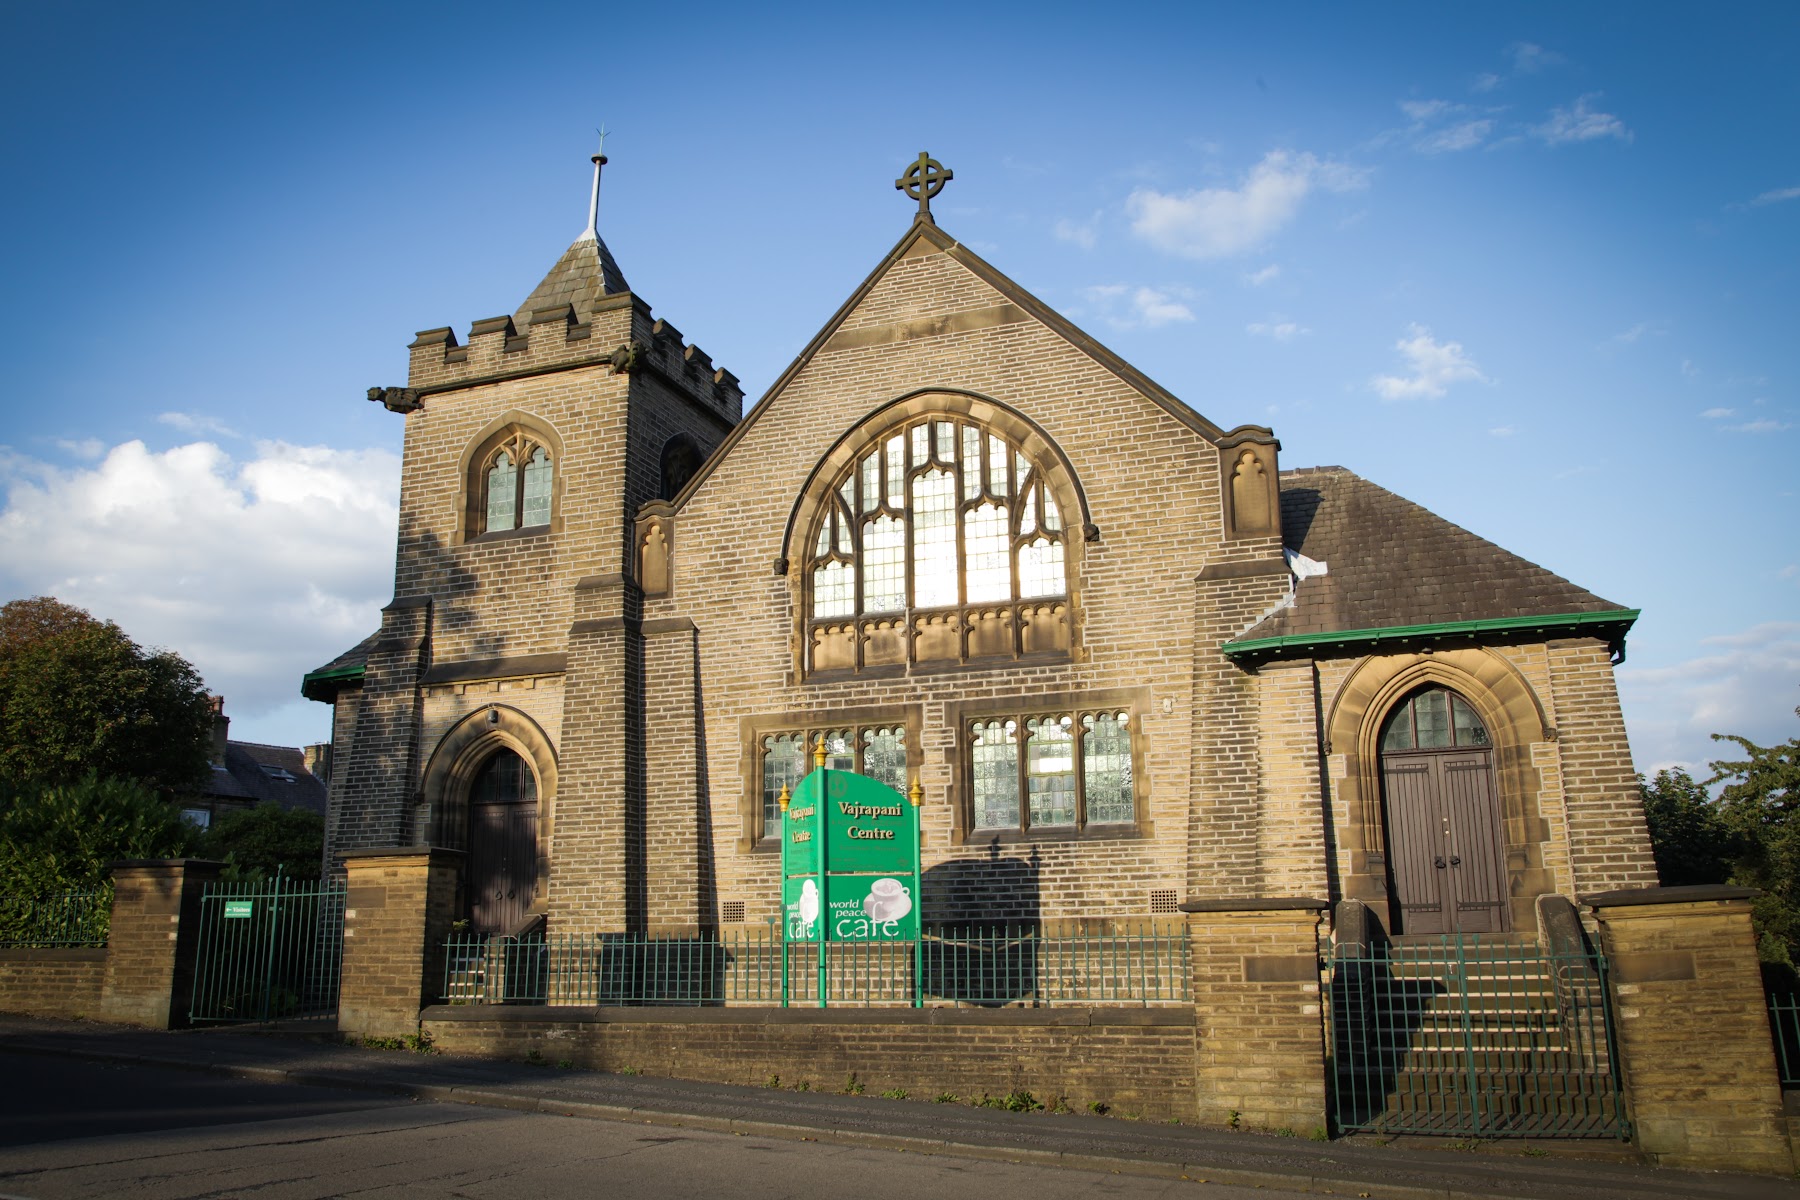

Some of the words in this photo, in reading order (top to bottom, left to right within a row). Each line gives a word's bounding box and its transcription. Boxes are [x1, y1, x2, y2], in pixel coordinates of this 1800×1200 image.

[838, 801, 902, 818] Vajrapani
[792, 831, 811, 843] Centre
[847, 826, 894, 839] Centre
[787, 901, 798, 910] world
[829, 899, 859, 908] world
[835, 910, 867, 919] peace
[836, 901, 899, 938] cafe
